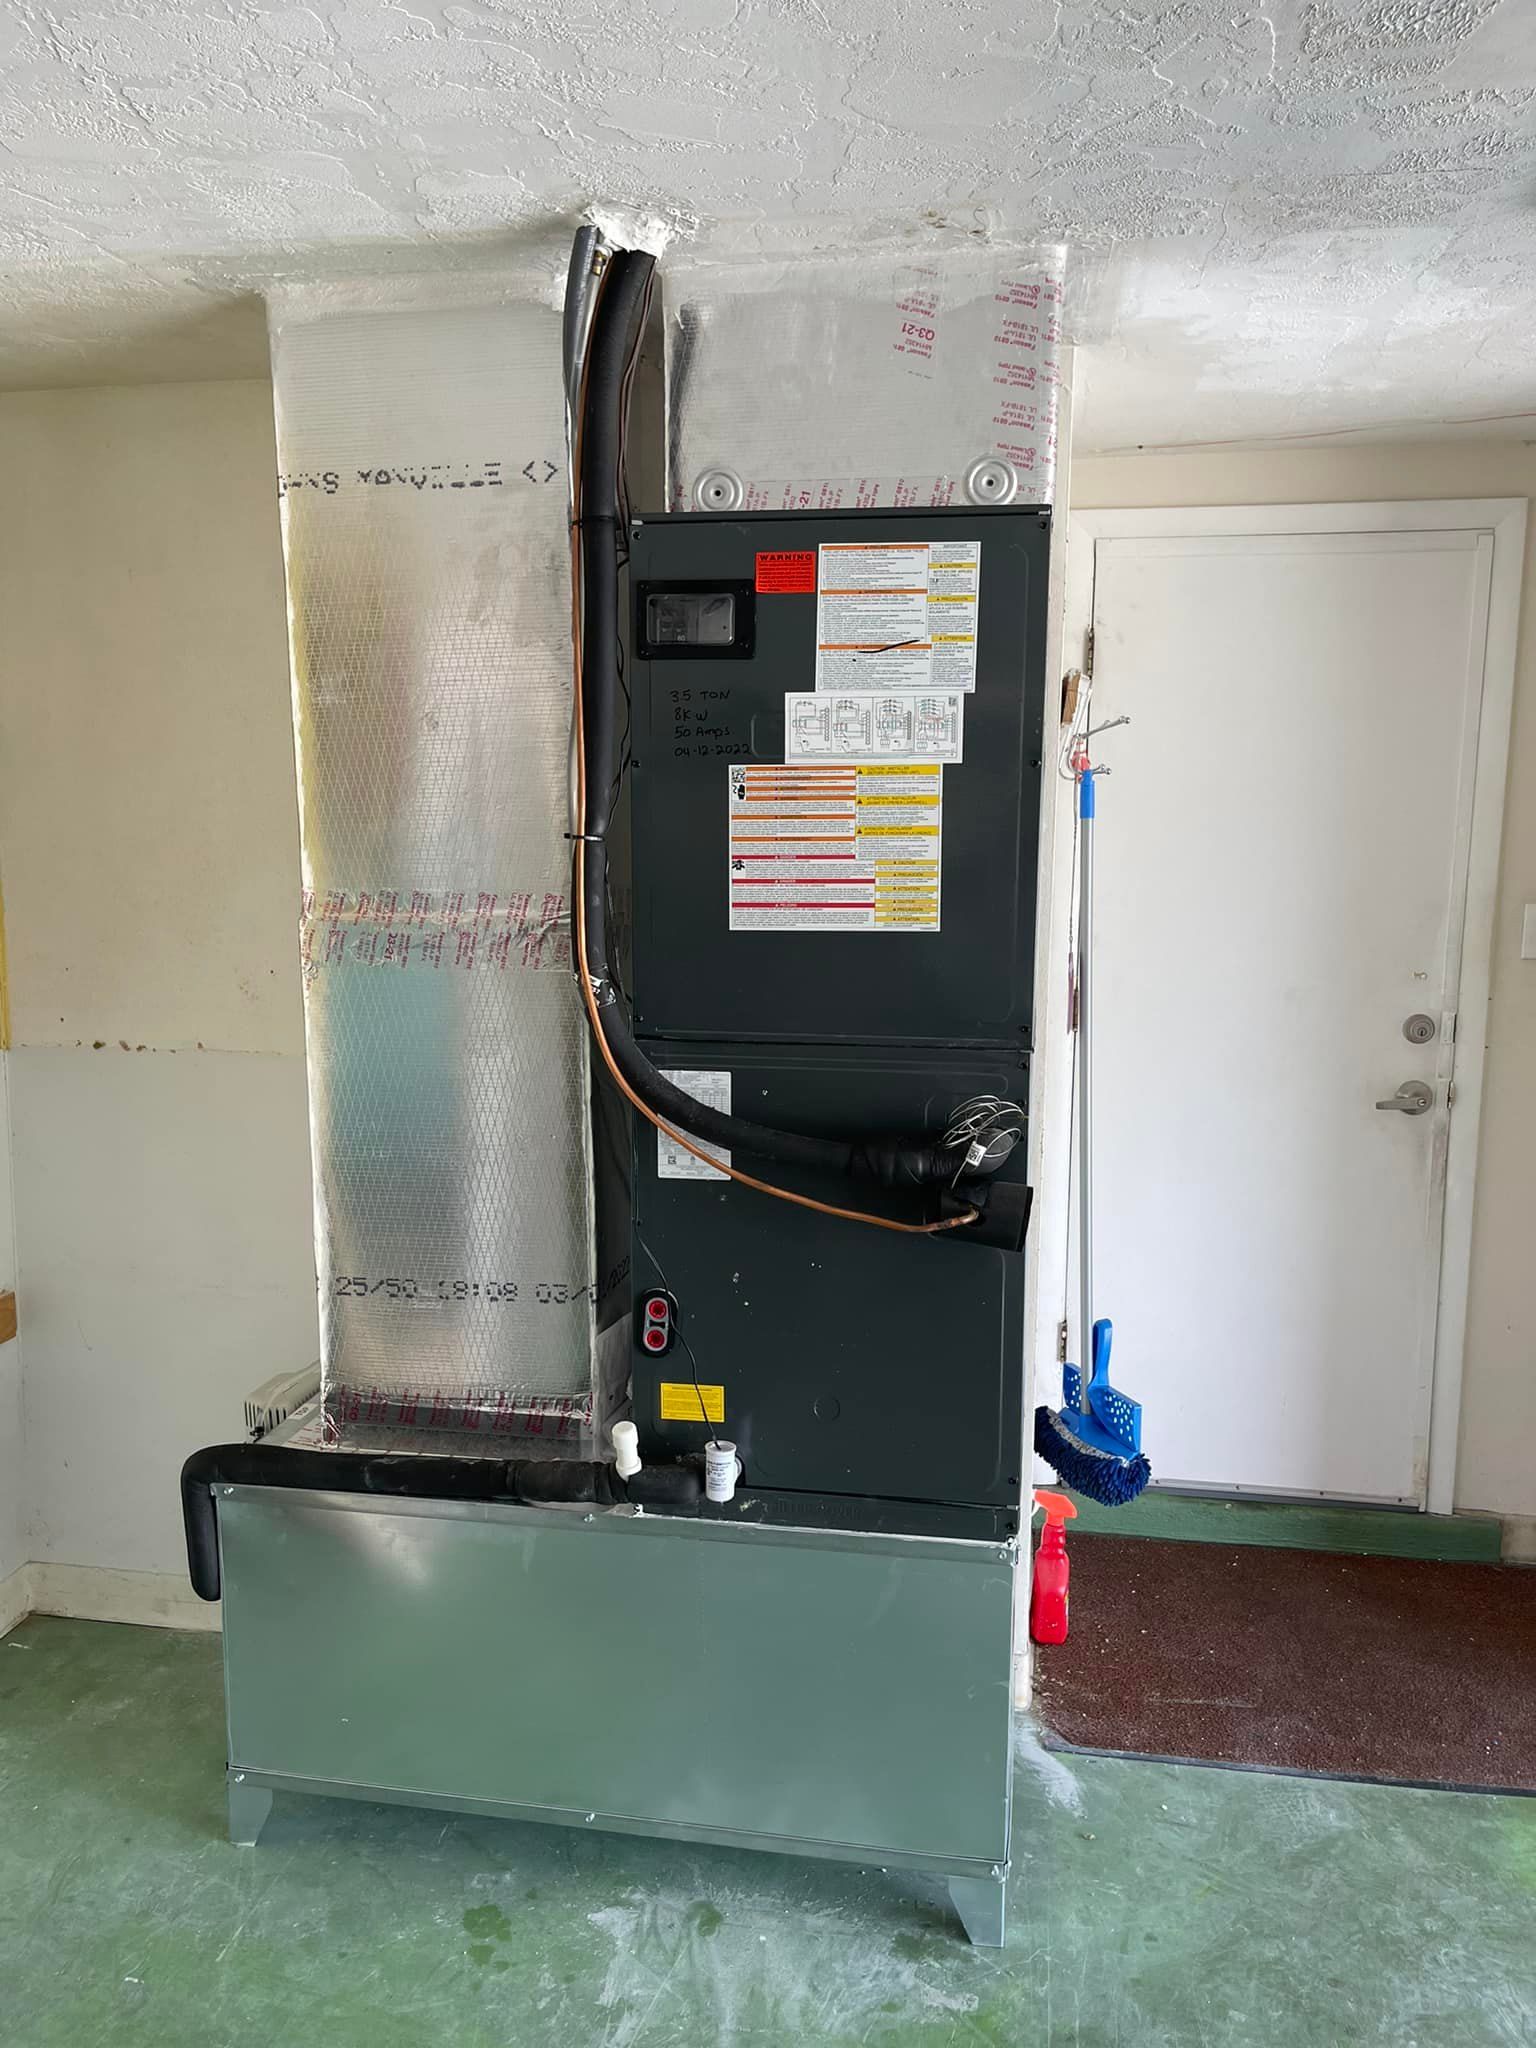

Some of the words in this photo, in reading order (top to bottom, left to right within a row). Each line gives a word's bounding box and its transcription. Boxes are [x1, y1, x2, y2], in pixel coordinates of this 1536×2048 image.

[901, 322, 936, 341] Q3-21
[800, 490, 811, 509] -21
[760, 553, 812, 561] WARNING
[700, 689, 730, 700] TON
[674, 725, 691, 740] 50
[696, 725, 730, 741] Amps
[674, 743, 753, 757] 04-12-2022
[335, 1276, 418, 1298] 25/50
